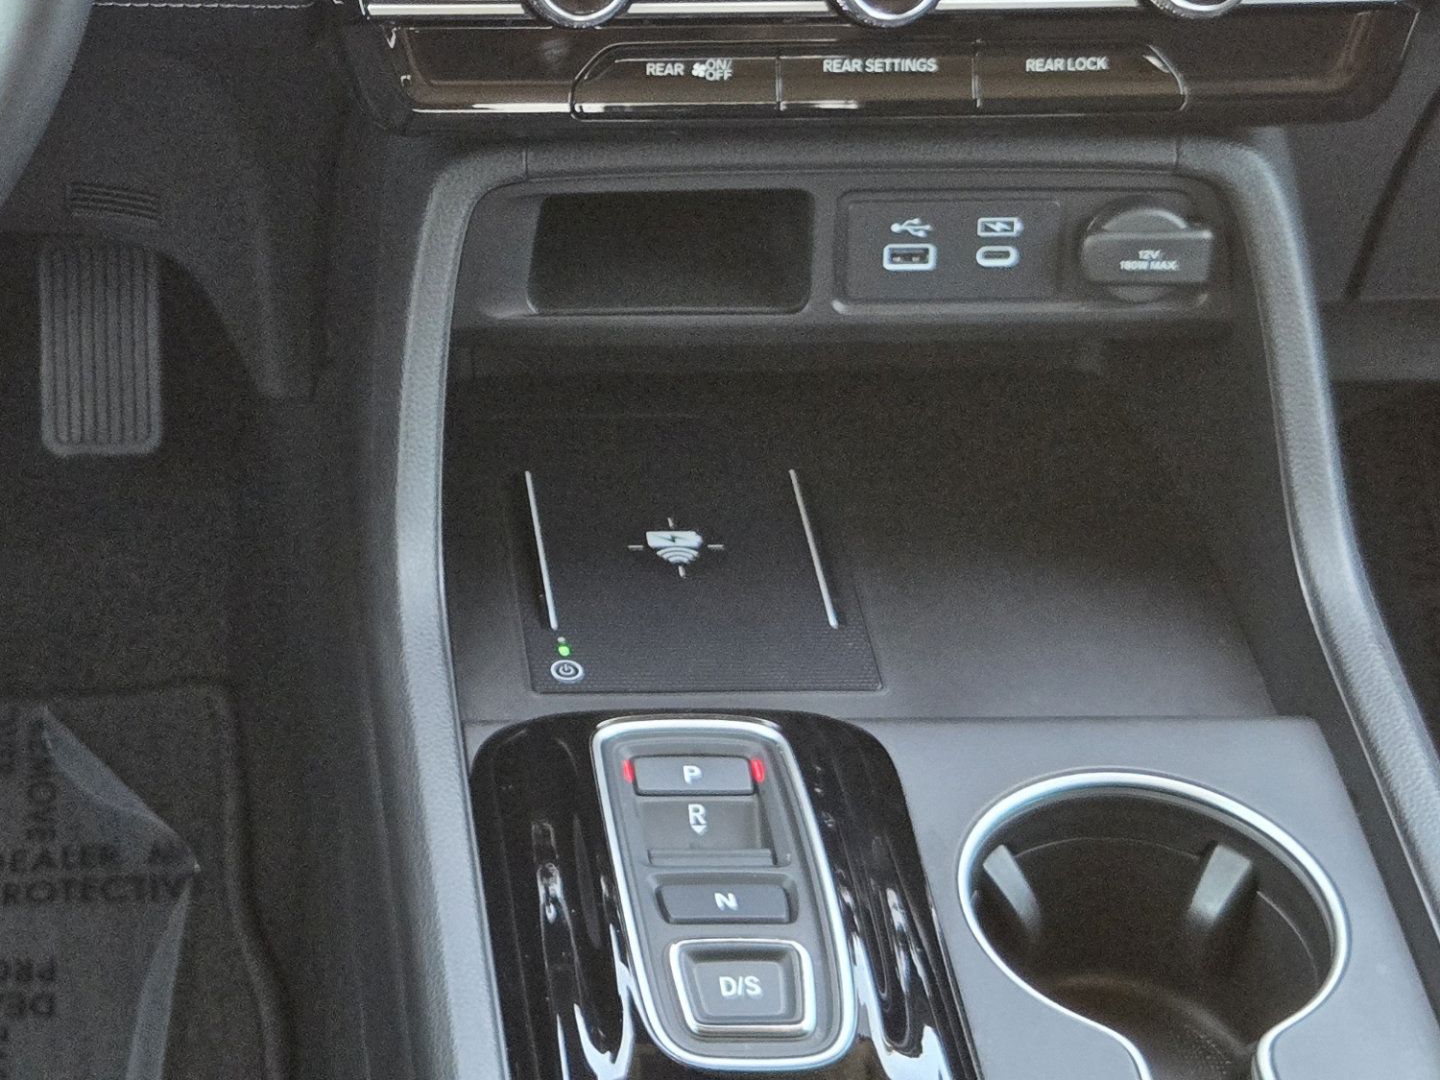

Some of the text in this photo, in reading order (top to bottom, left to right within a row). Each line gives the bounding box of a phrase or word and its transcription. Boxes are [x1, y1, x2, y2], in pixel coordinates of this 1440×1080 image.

[646, 63, 683, 76] REAR
[706, 58, 732, 70] ON/
[823, 58, 938, 72] REAR SETTINGS
[1025, 56, 1108, 72] REAR LOCK
[706, 70, 732, 81] OFF
[683, 765, 701, 783] P
[688, 803, 707, 824] R
[714, 892, 738, 912] N
[719, 976, 762, 998] D/S
